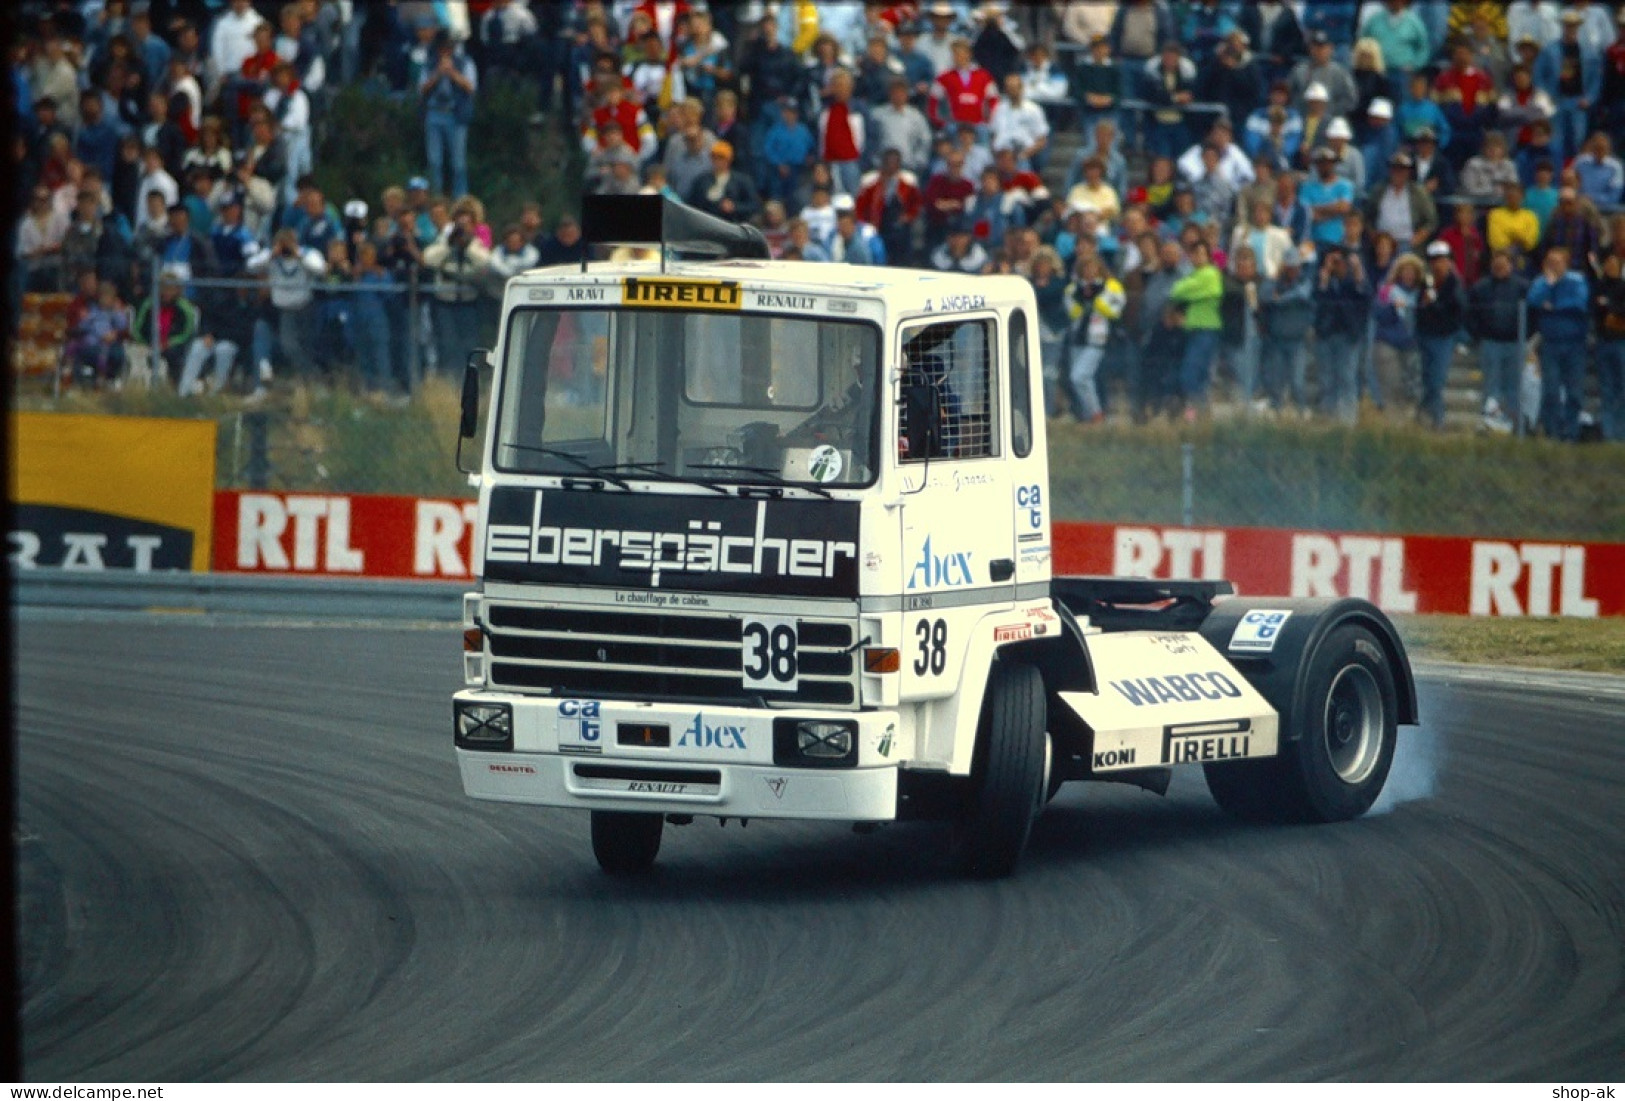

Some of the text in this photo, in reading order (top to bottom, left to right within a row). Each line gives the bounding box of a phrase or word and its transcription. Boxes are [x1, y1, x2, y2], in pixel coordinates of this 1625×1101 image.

[626, 278, 738, 303] PIRELLI
[757, 294, 817, 310] RENAULT
[238, 493, 364, 573] RTL
[906, 532, 974, 588] Abex
[1291, 533, 1418, 613] RTL
[1471, 541, 1599, 617] RTL
[744, 622, 796, 682] 38
[913, 618, 948, 677] 38
[994, 622, 1032, 642] PIRELLI
[1108, 671, 1242, 706] WABCO
[678, 711, 746, 749] Abex
[1161, 718, 1251, 764] PIRELLI
[1094, 748, 1136, 767] KONI
[627, 782, 688, 793] RENAULT
